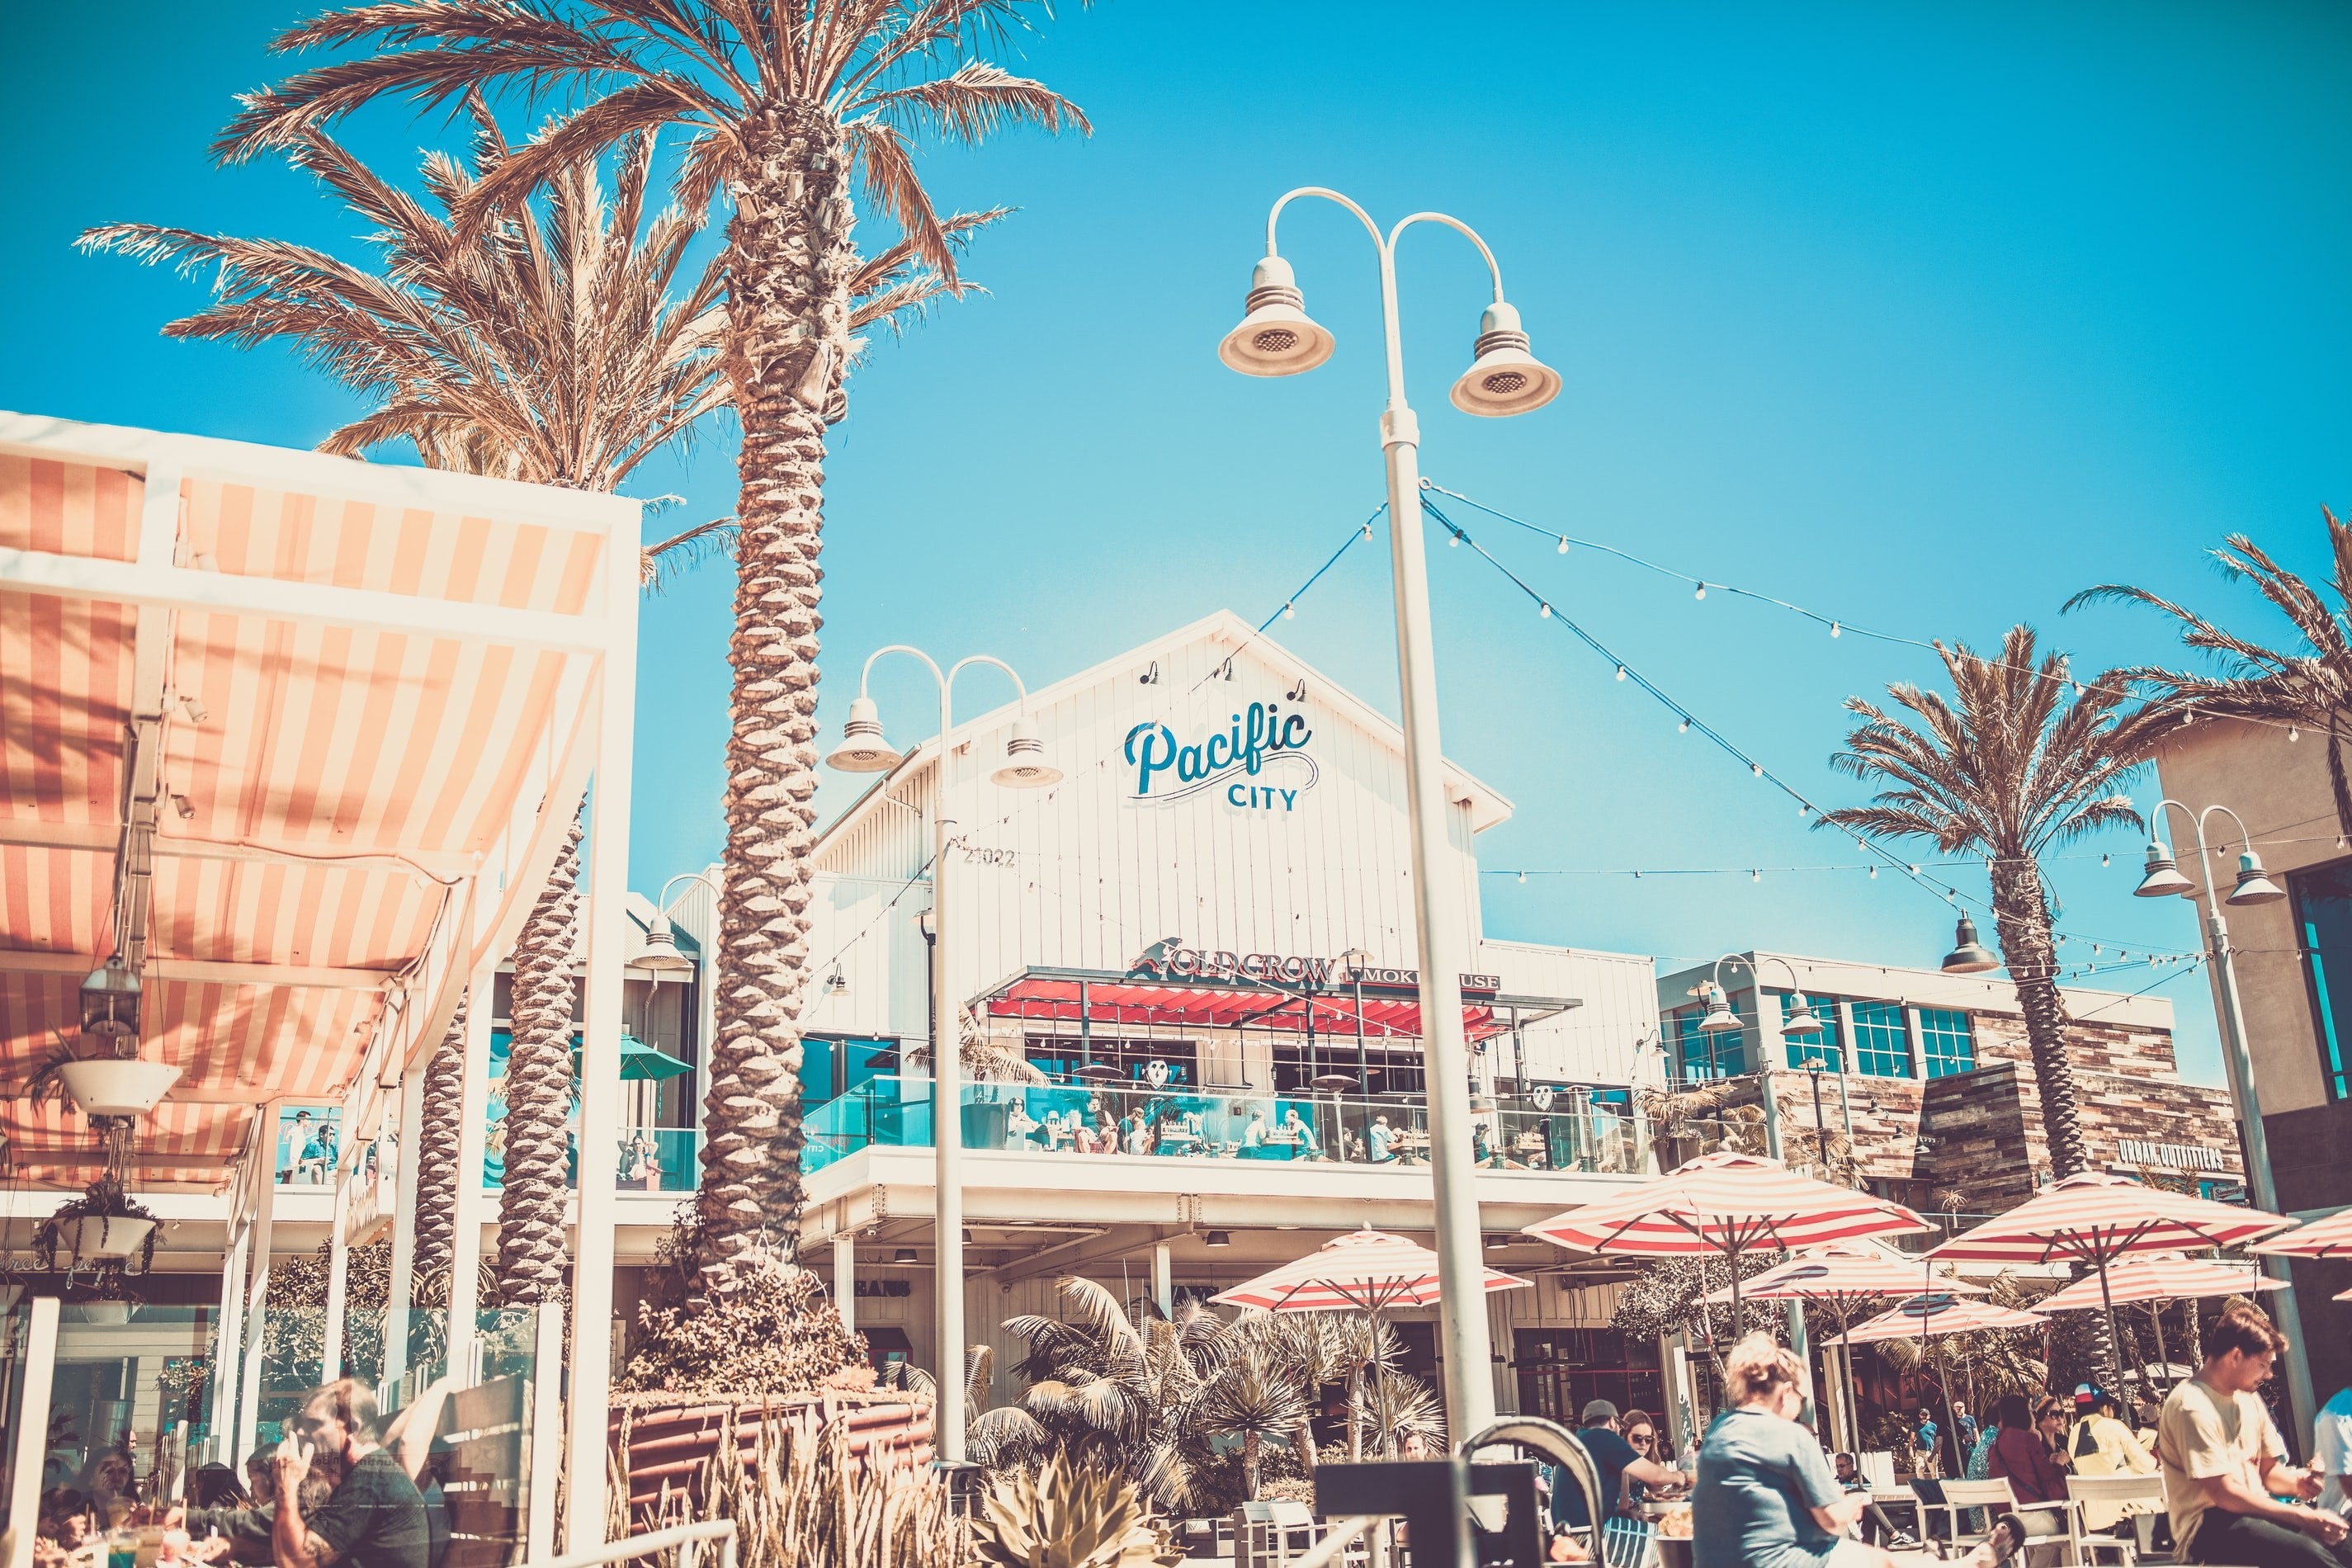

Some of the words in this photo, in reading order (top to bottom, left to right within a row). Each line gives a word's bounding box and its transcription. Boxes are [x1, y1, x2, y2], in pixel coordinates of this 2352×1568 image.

[1124, 701, 1312, 795] Pacific
[1227, 784, 1297, 811] CITY
[1171, 949, 1238, 977] OLD
[1240, 953, 1337, 983] CROW
[2118, 1139, 2160, 1164] URBAN
[2159, 1143, 2224, 1171] OUTFITTERS
